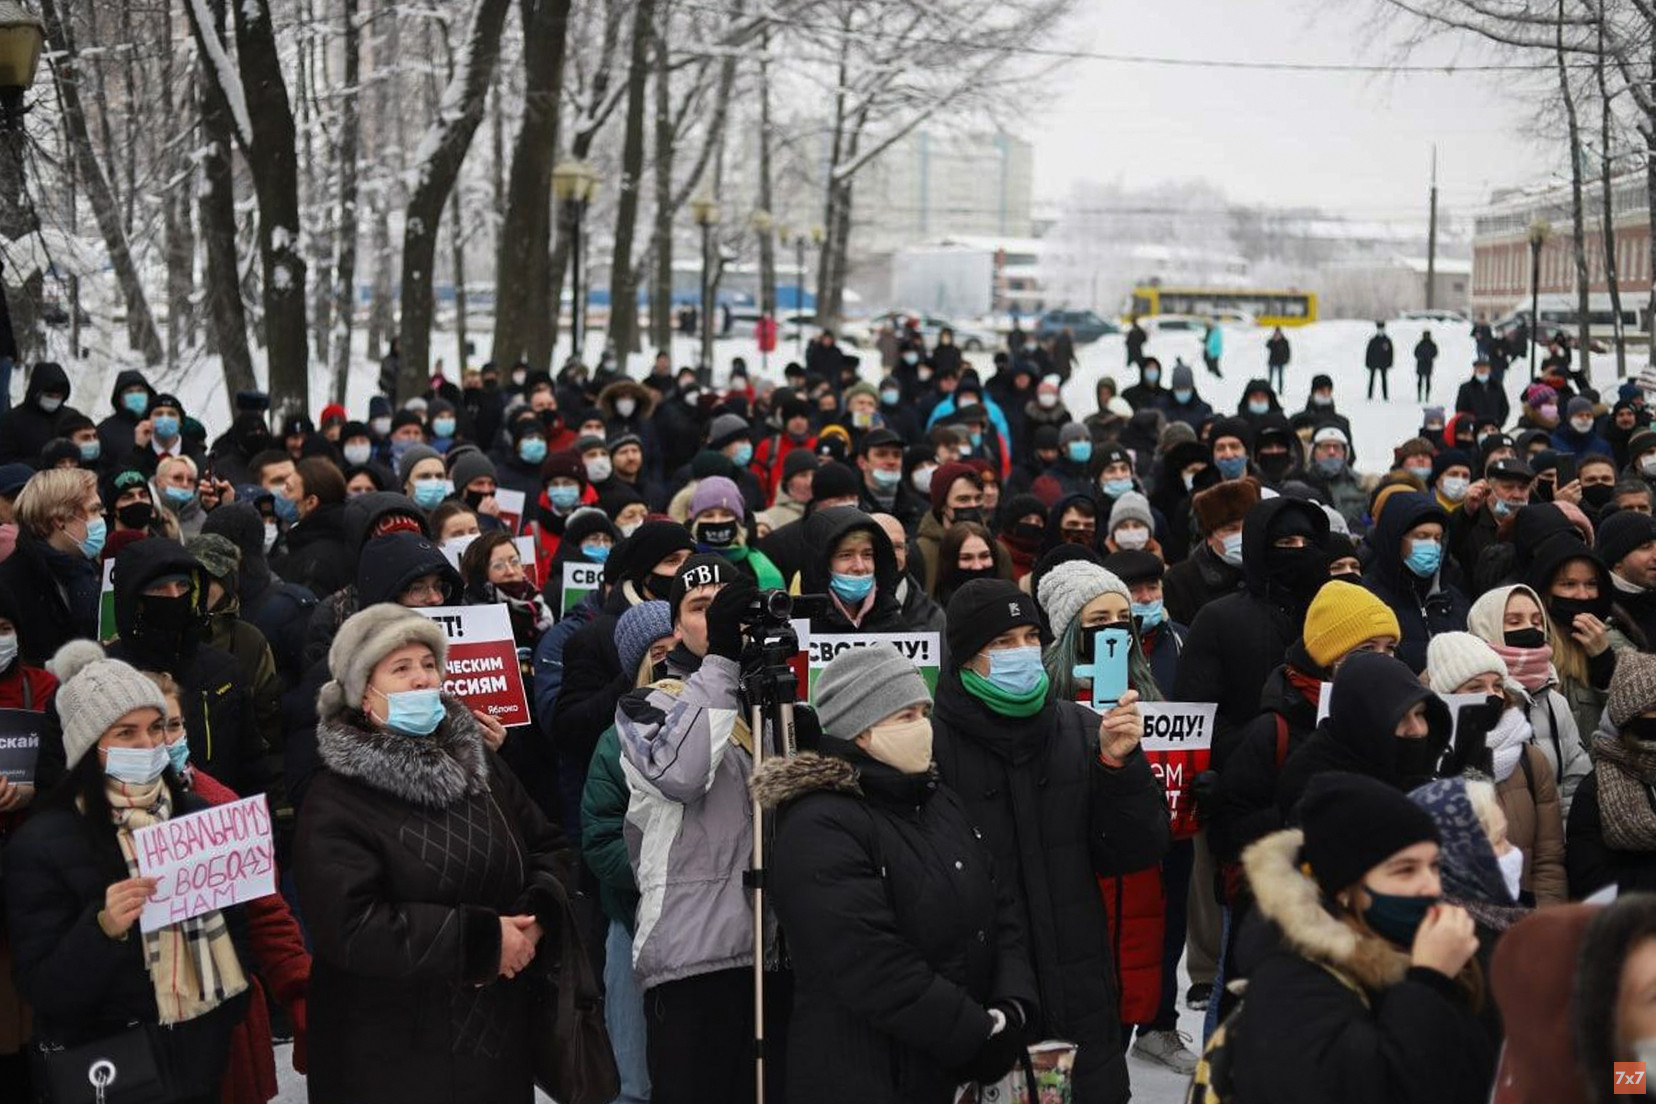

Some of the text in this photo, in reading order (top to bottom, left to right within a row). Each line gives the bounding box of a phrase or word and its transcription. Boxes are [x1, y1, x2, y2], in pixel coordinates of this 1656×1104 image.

[682, 564, 720, 592] FBI
[426, 615, 464, 637] Т!
[809, 640, 929, 662] СВОУ!
[445, 656, 504, 674] ЧЕСКИМ
[440, 675, 508, 696] ССИЯМ
[1143, 715, 1205, 741] БОДУ!
[142, 801, 270, 869] НАВАЛЬНОМУ
[170, 882, 236, 921] НАМ
